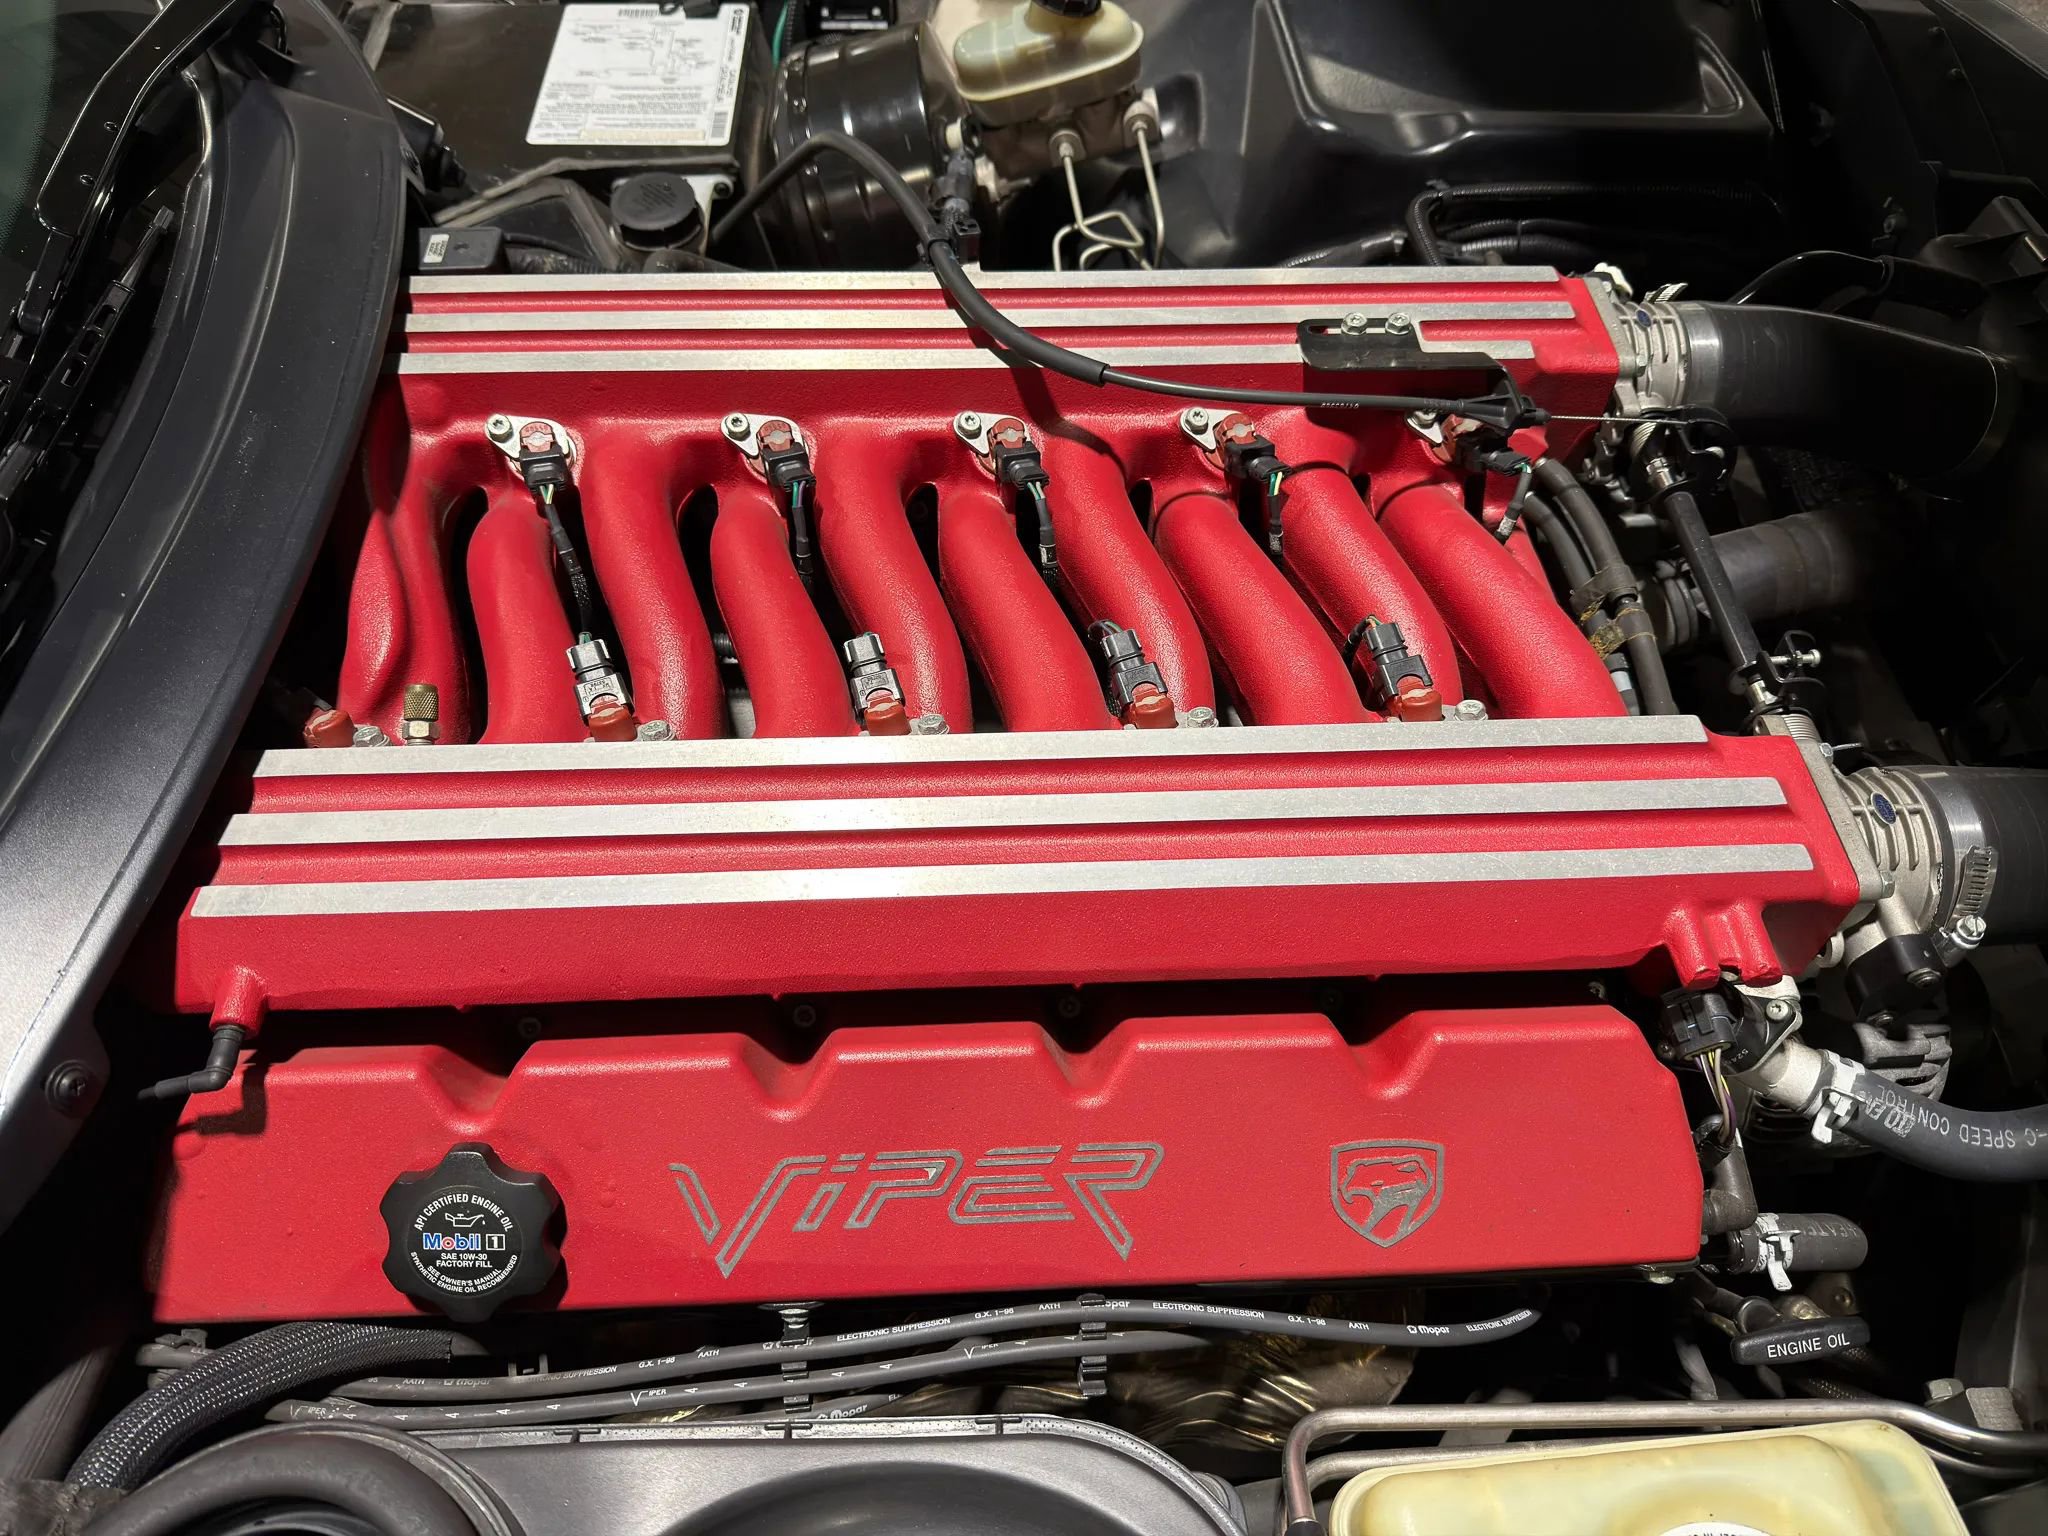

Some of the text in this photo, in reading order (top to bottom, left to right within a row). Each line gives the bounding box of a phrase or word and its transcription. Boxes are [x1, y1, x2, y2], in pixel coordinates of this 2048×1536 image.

[1878, 1084, 1950, 1137] CONTROL
[1959, 1123, 2016, 1148] SPEED
[413, 1193, 514, 1232] API CERTIFIED ENGINE OIL
[422, 1232, 481, 1251] Mobil
[410, 1251, 518, 1293] SYNTHETIC ENGINE OIL RECOMMENDED
[426, 1265, 502, 1286] SEE OWNER'S MANUAL
[436, 1260, 493, 1268] FACTORY FILL
[837, 1328, 890, 1342] ELECTRONIC
[892, 1318, 951, 1333] SUPPRESSION
[1038, 1302, 1061, 1311] AATH
[1152, 1302, 1205, 1312] ELECTRONIC
[1206, 1305, 1265, 1320] SUPPRESSION
[1348, 1321, 1370, 1331] AATH
[1418, 1325, 1450, 1336] Mopar
[1465, 1320, 1503, 1332] ELECTRONIC
[1767, 1332, 1850, 1358] ENGINE OIL
